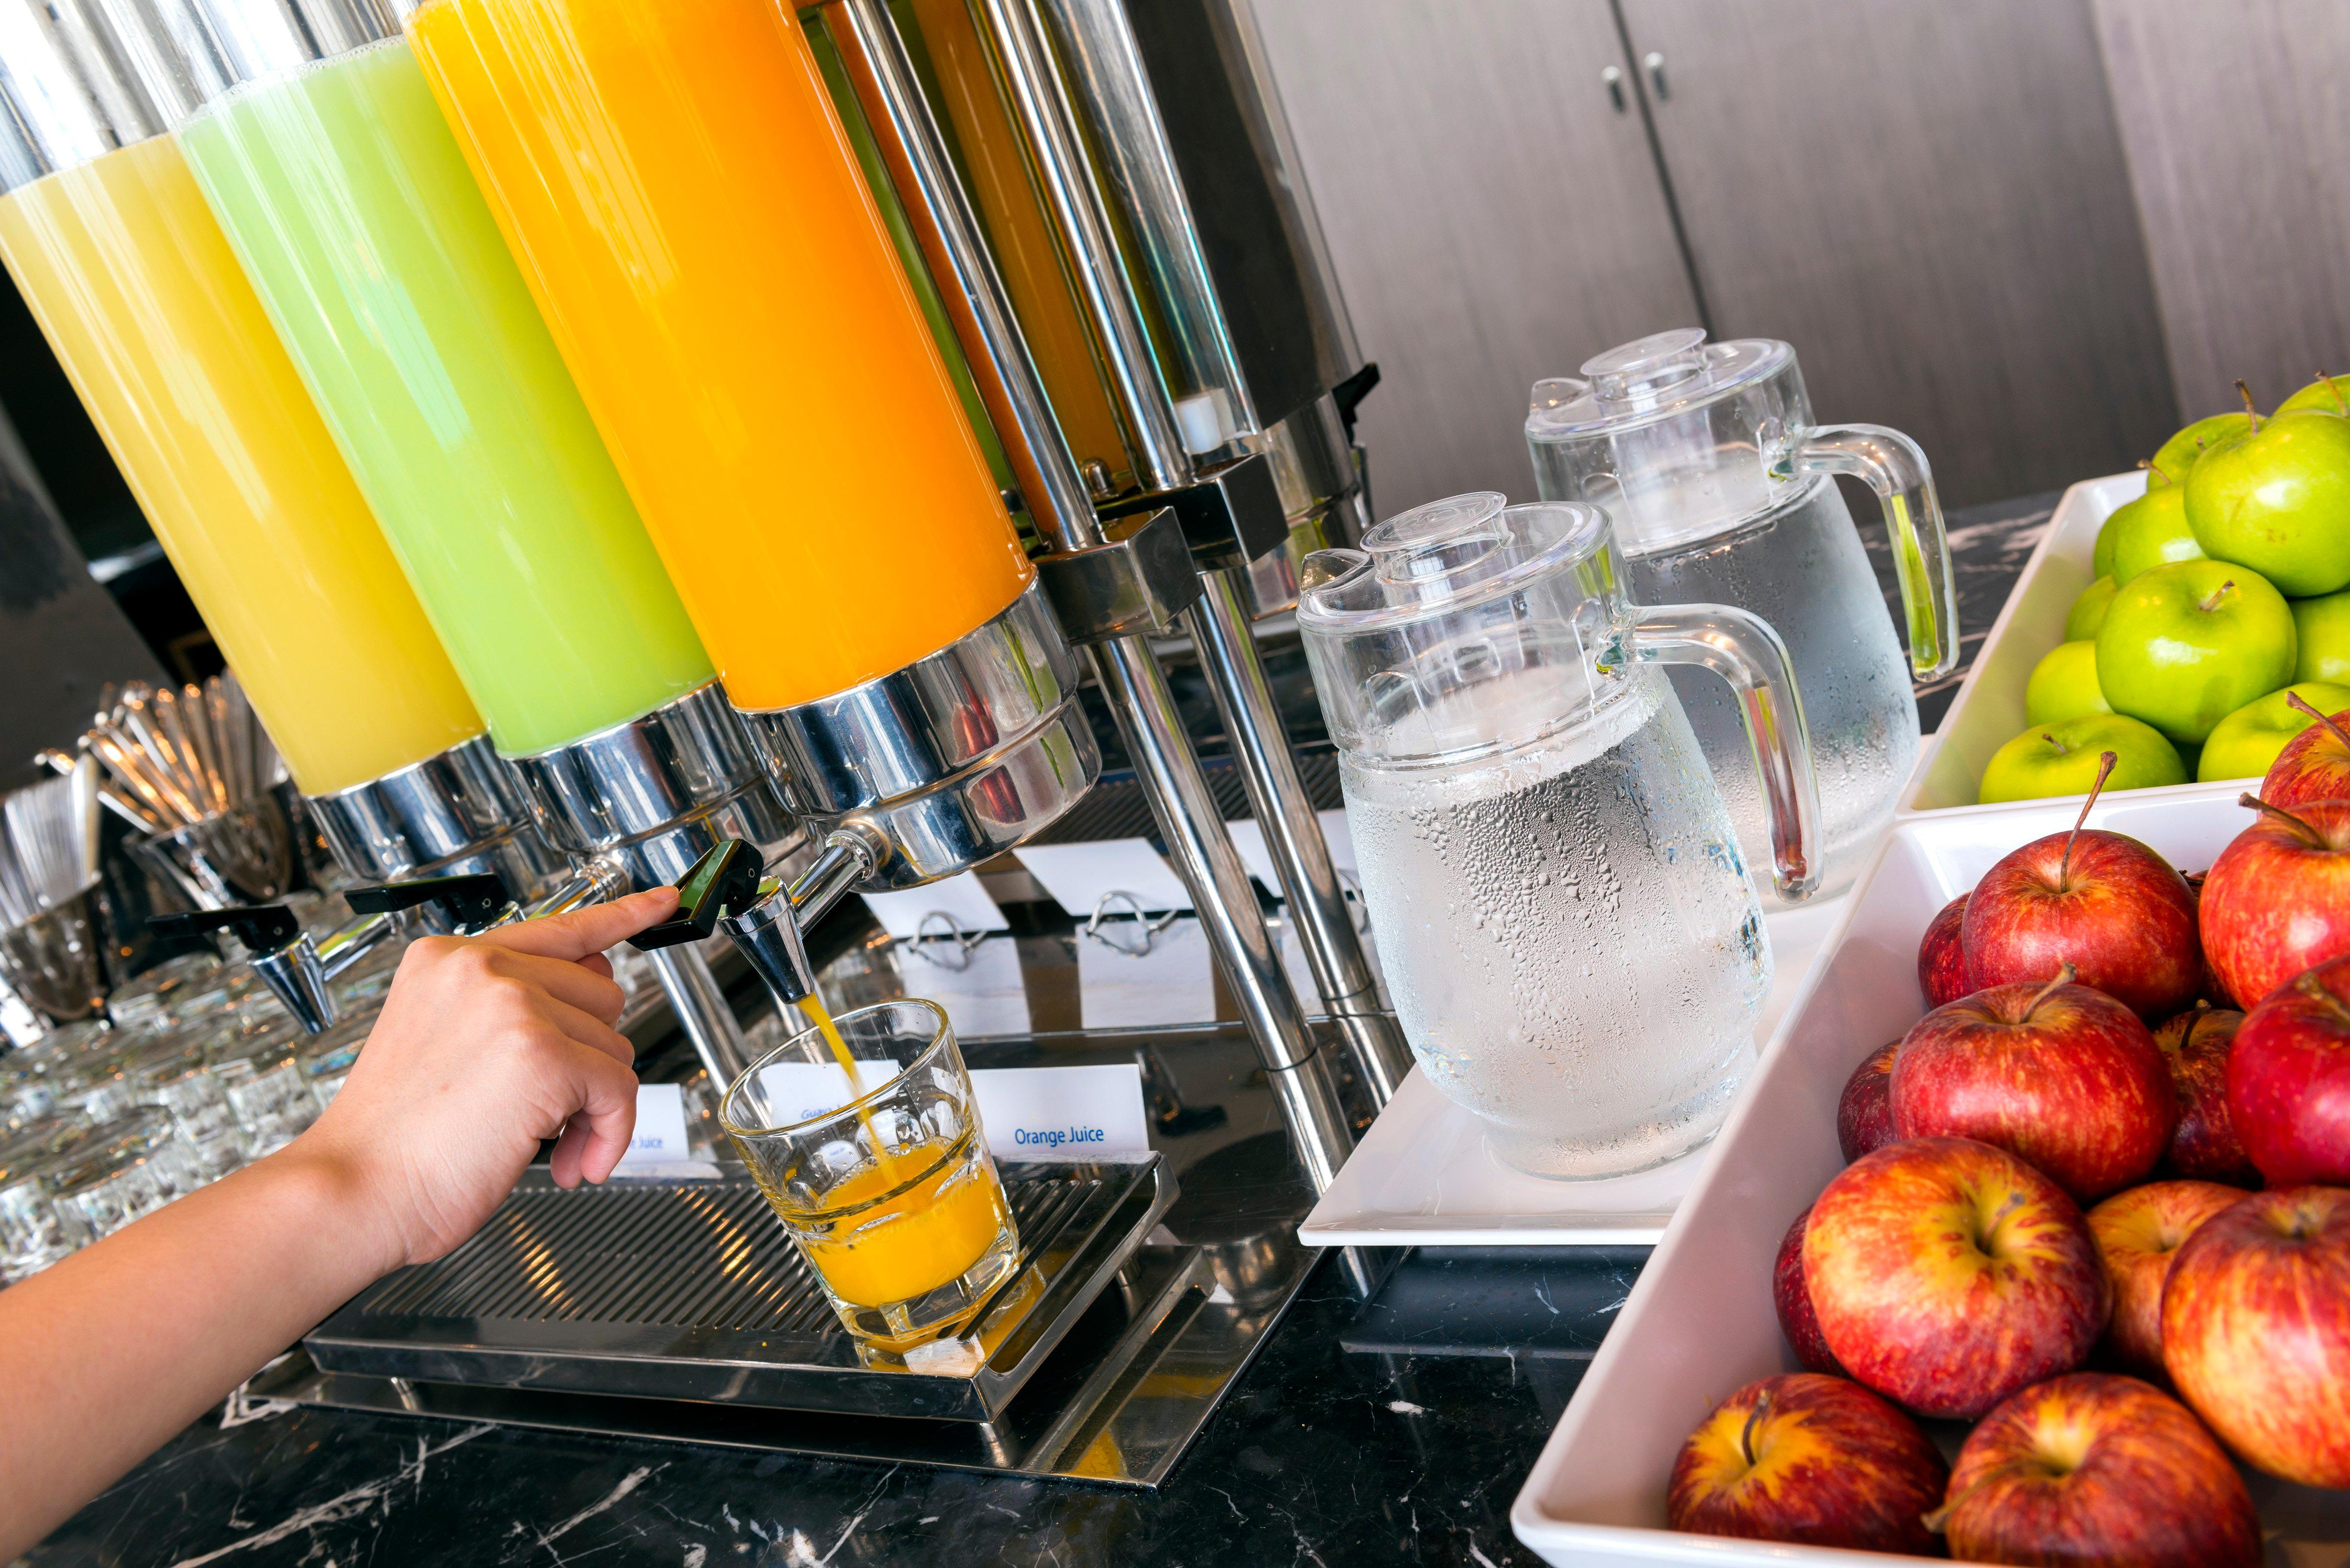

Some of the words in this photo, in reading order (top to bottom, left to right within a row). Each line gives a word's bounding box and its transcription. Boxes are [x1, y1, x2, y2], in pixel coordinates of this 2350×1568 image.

[638, 1134, 663, 1149] Juice
[1015, 1128, 1066, 1148] Orange
[1069, 1126, 1104, 1143] Juice
